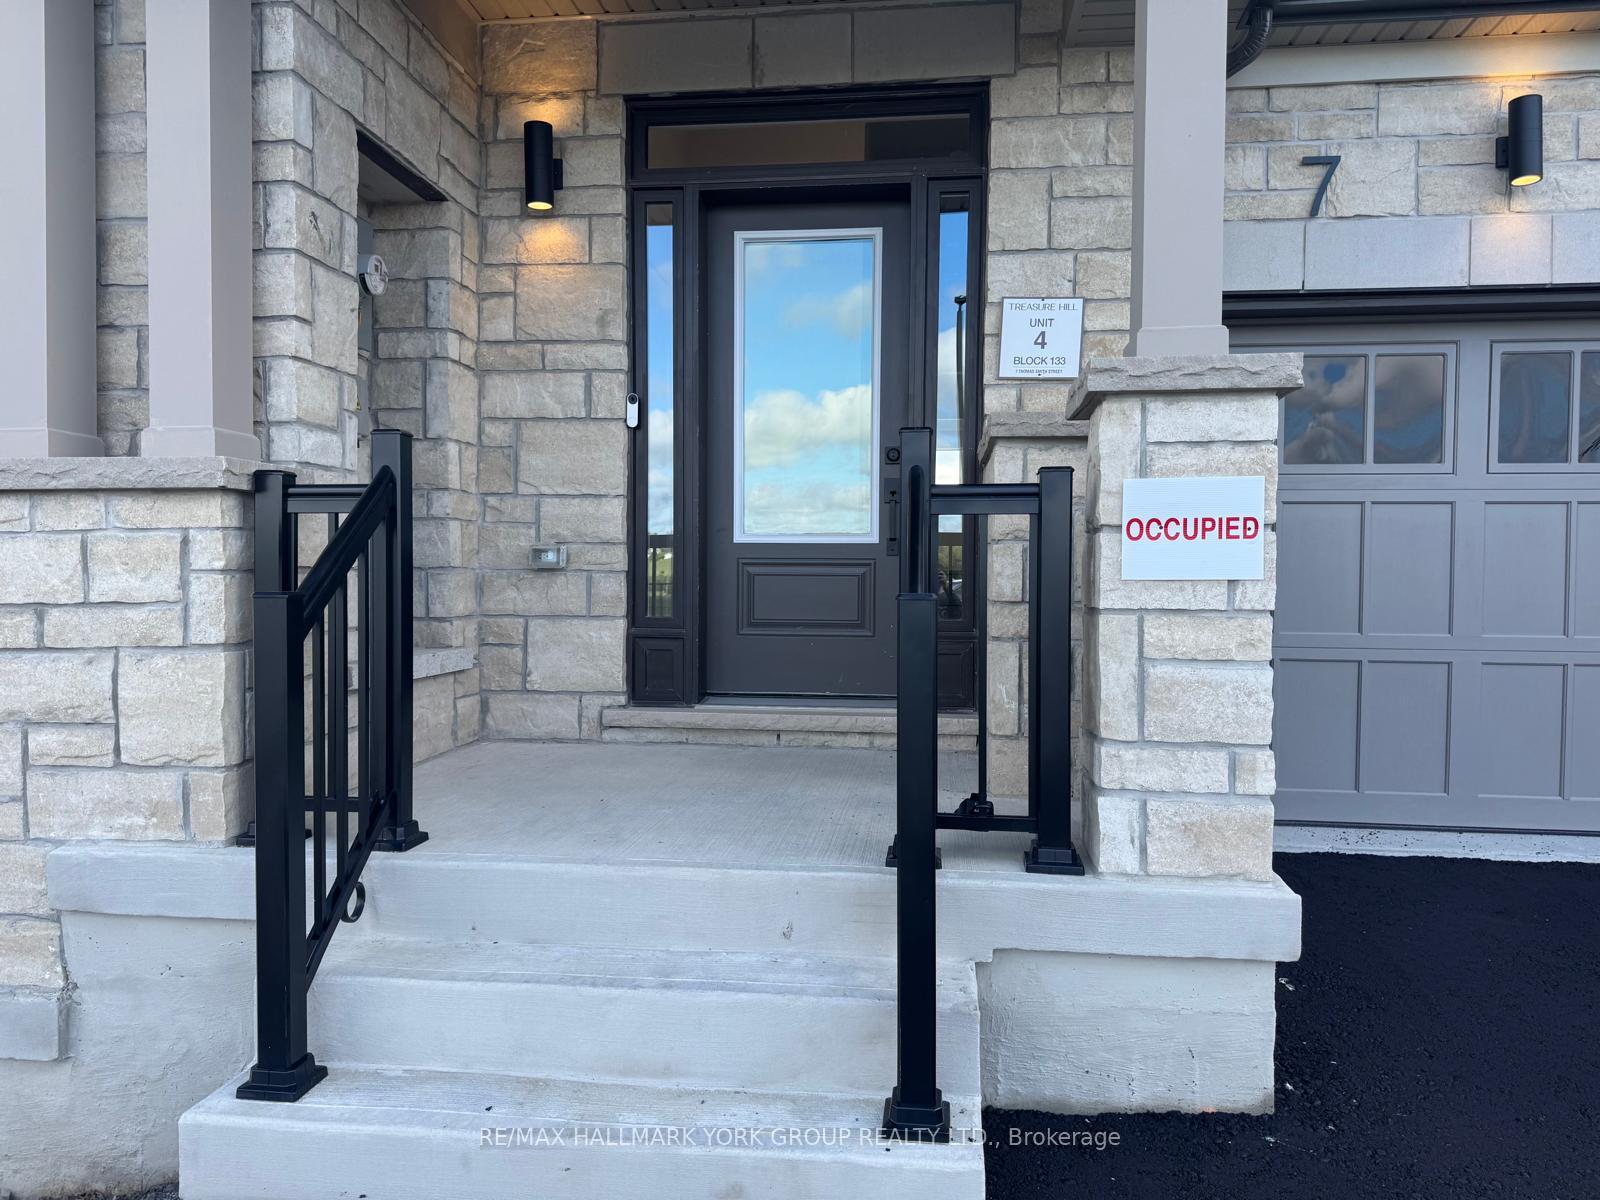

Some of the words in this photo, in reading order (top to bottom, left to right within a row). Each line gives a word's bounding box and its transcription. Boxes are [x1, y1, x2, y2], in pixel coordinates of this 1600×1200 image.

[1301, 155, 1341, 216] 7
[1008, 302, 1056, 311] TREASURE
[1058, 302, 1078, 311] HILL
[1029, 318, 1055, 328] UNIT
[1033, 330, 1047, 350] 4
[1013, 356, 1048, 365] BLOCK
[1050, 356, 1066, 365] 133
[1125, 516, 1260, 542] OCCUPIED
